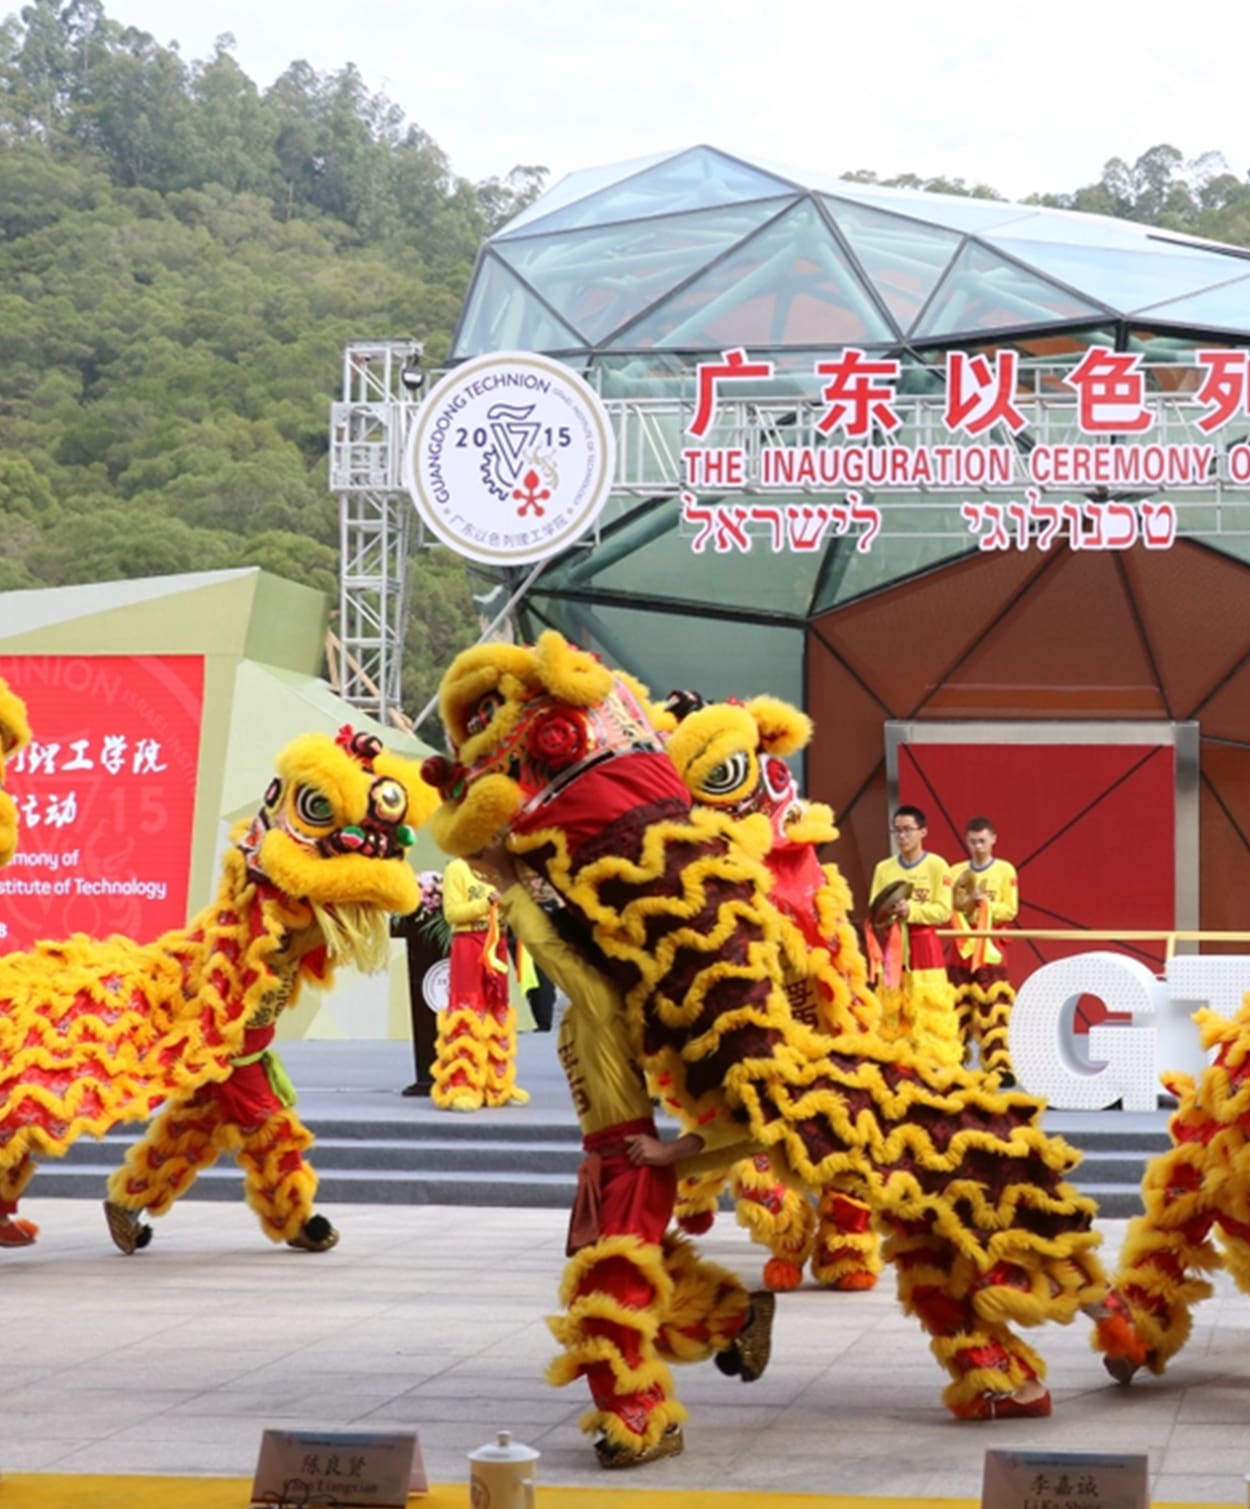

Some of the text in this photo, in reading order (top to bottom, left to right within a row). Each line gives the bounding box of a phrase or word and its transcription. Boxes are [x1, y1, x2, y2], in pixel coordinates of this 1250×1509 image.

[428, 372, 551, 504] GUANGDONG TECHNION
[684, 450, 742, 484] THE
[764, 448, 1010, 484] INAUGURATION
[1032, 447, 1212, 482] CEREMONY
[684, 494, 879, 550] לישראל
[963, 490, 1174, 547] טכנולוגי
[62, 849, 79, 866] of
[54, 877, 71, 895] of
[75, 877, 167, 900] Technology
